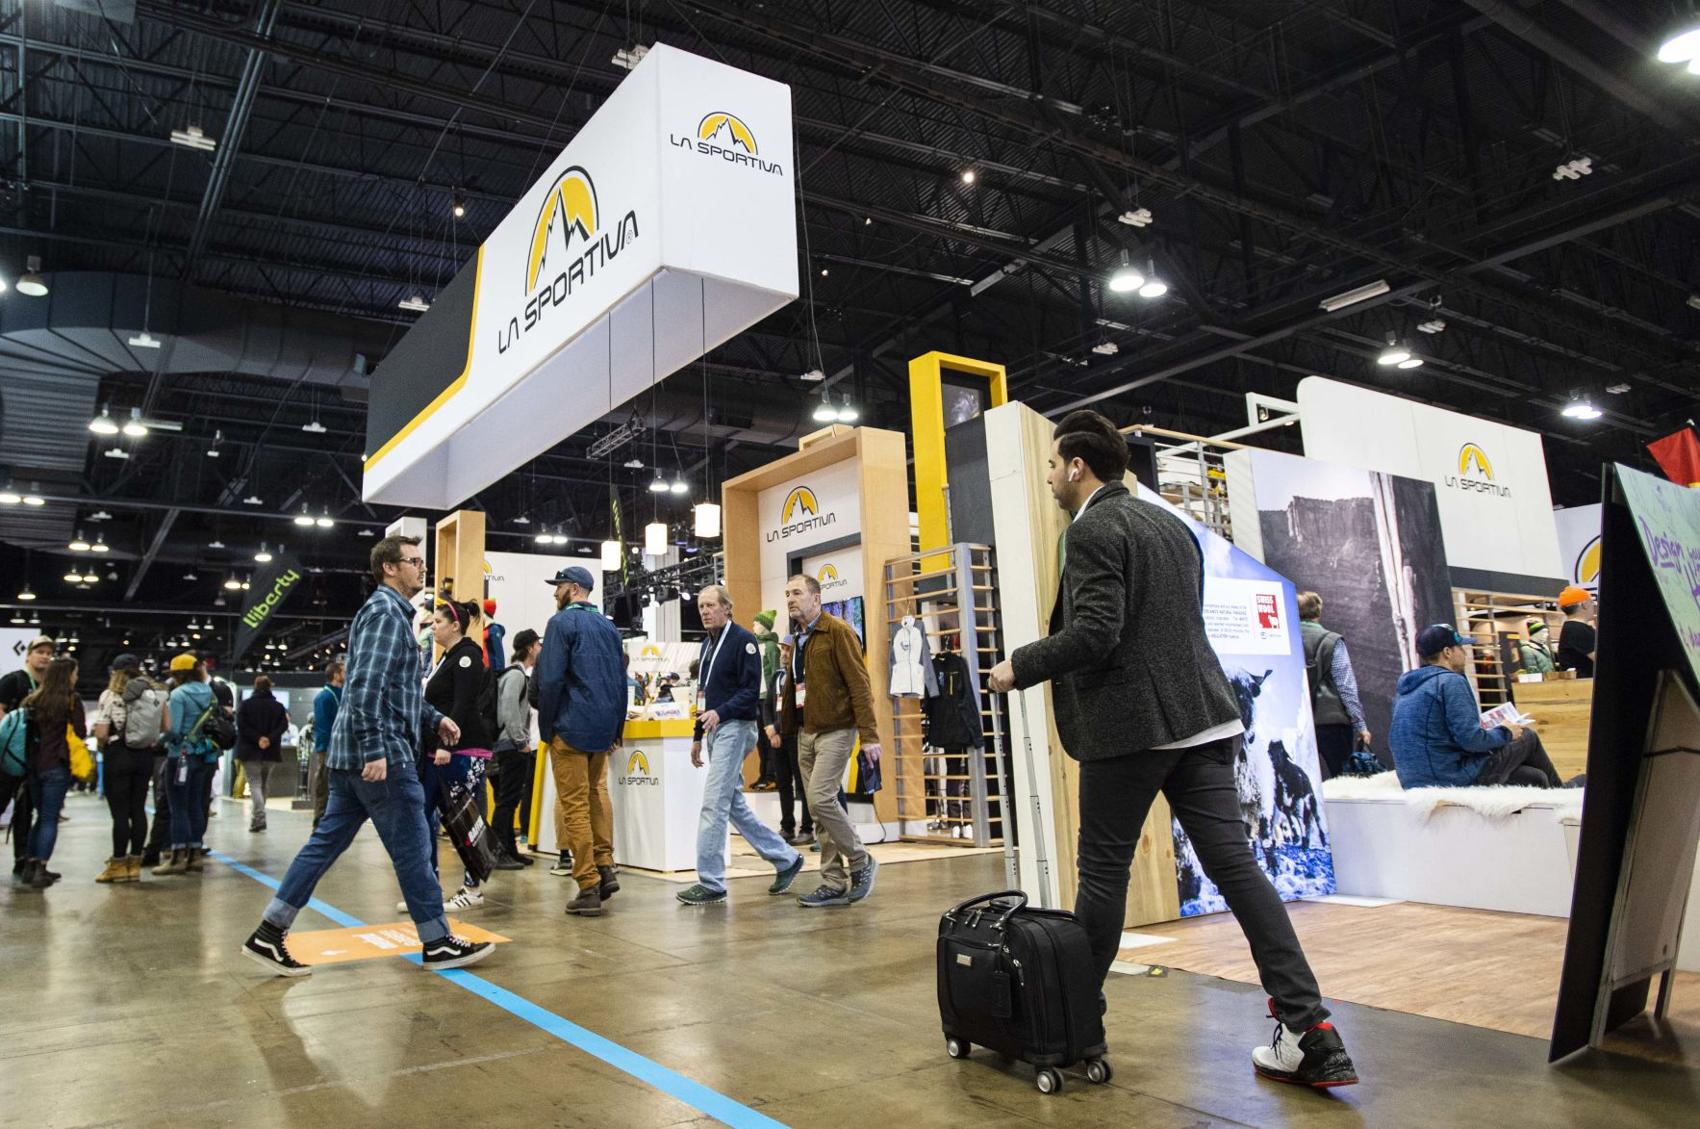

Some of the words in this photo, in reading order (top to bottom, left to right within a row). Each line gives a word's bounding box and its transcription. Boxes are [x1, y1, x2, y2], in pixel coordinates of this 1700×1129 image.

[670, 133, 692, 150] LA
[697, 141, 783, 176] SPORTIVA
[498, 316, 520, 355] LA
[524, 209, 639, 332] SPORTIVA
[1444, 474, 1459, 488] LA
[1460, 478, 1512, 498] SPORTIVA
[766, 529, 780, 543] LA
[781, 511, 837, 539] SPORTIVA
[618, 776, 627, 785] LA
[627, 776, 659, 786] SPORTIVA
